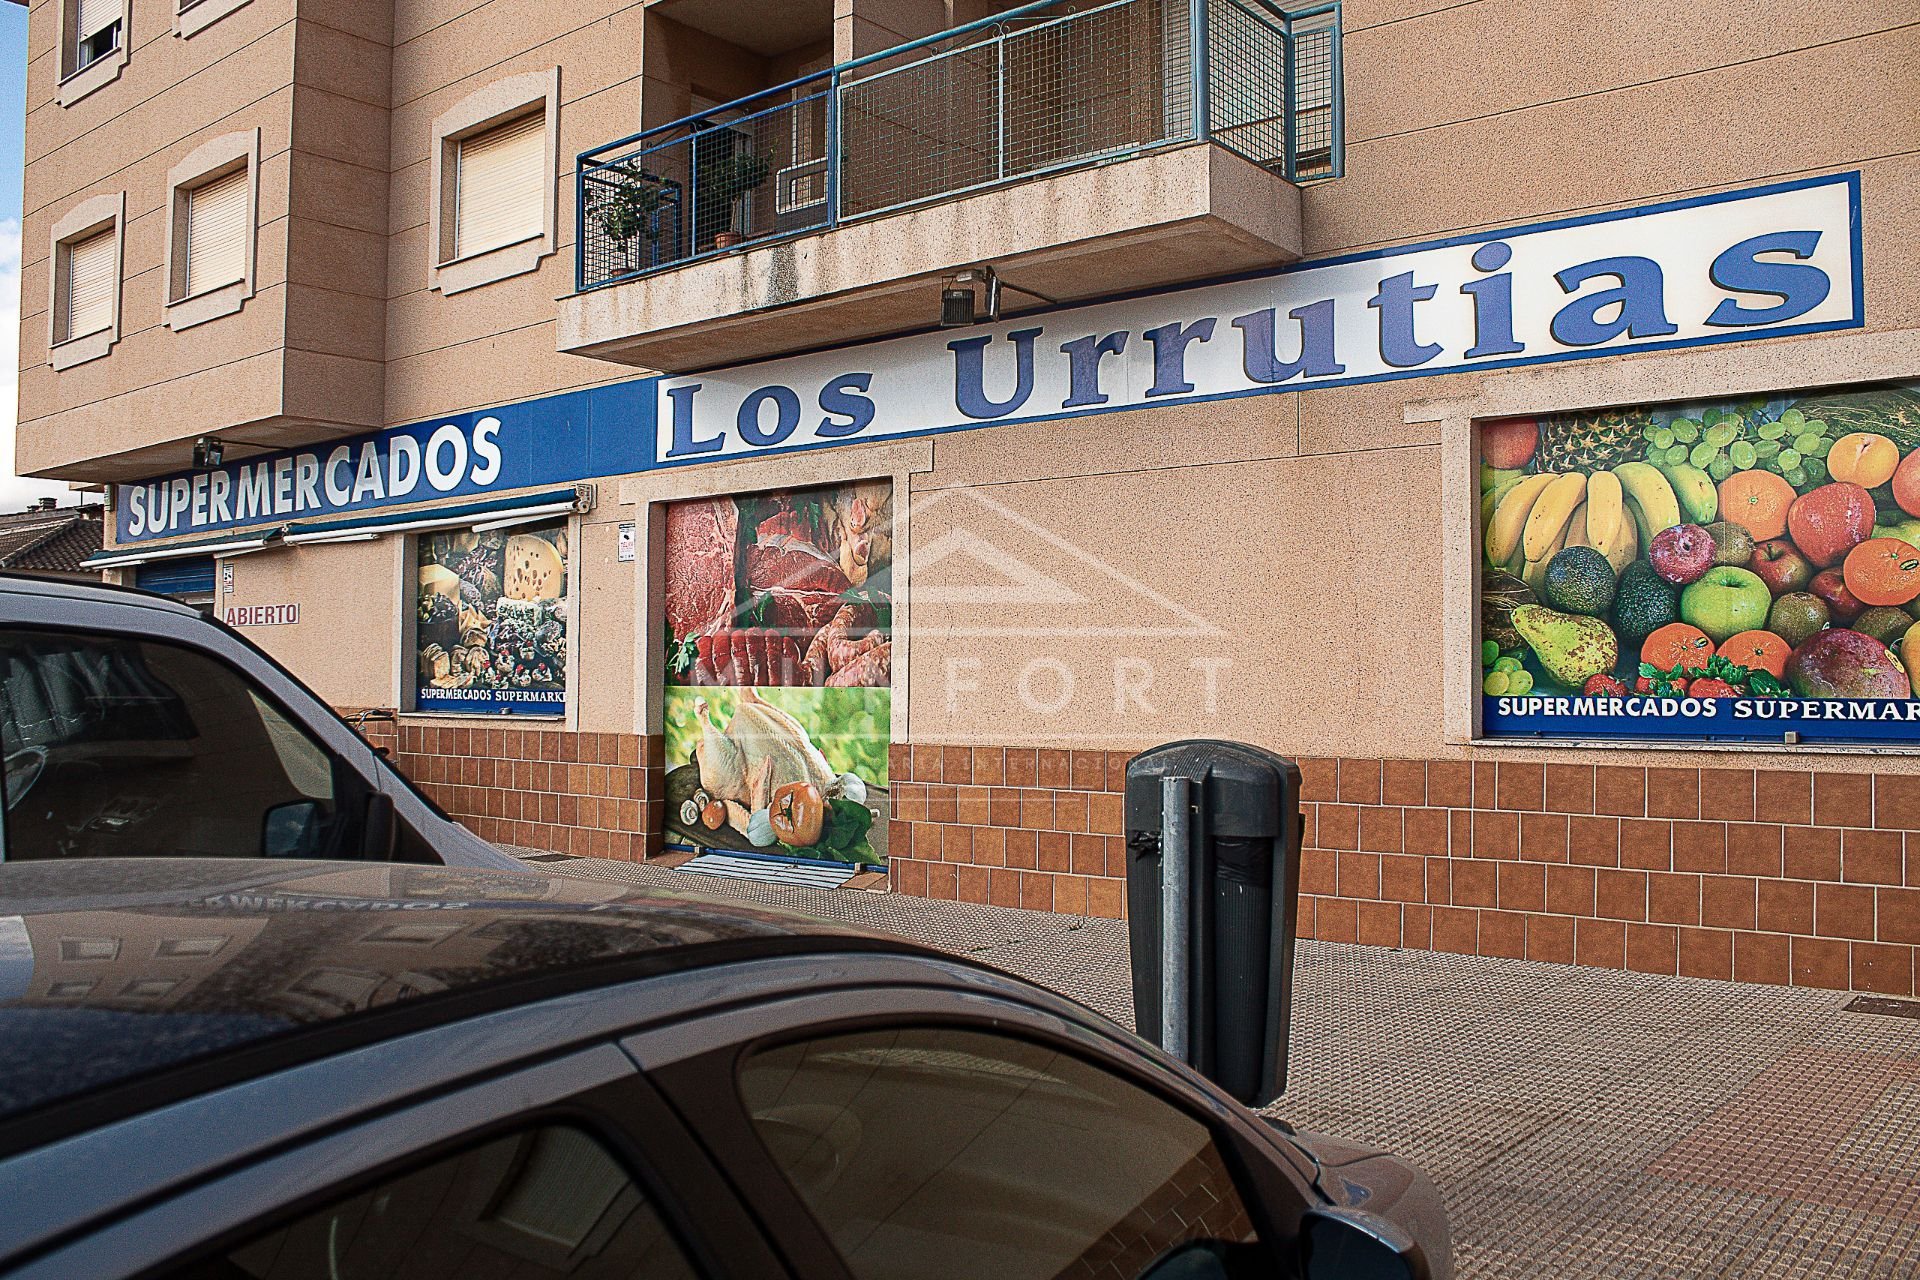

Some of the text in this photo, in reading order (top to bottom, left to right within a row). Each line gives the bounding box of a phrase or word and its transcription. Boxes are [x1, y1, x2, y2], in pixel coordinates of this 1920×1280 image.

[128, 230, 1832, 537] SUPERMERCADOS Los Urrutias
[226, 604, 297, 625] ABIERTO
[421, 688, 492, 700] SUPERMERCADOS
[1498, 697, 1717, 718] SUPERMERCADOS
